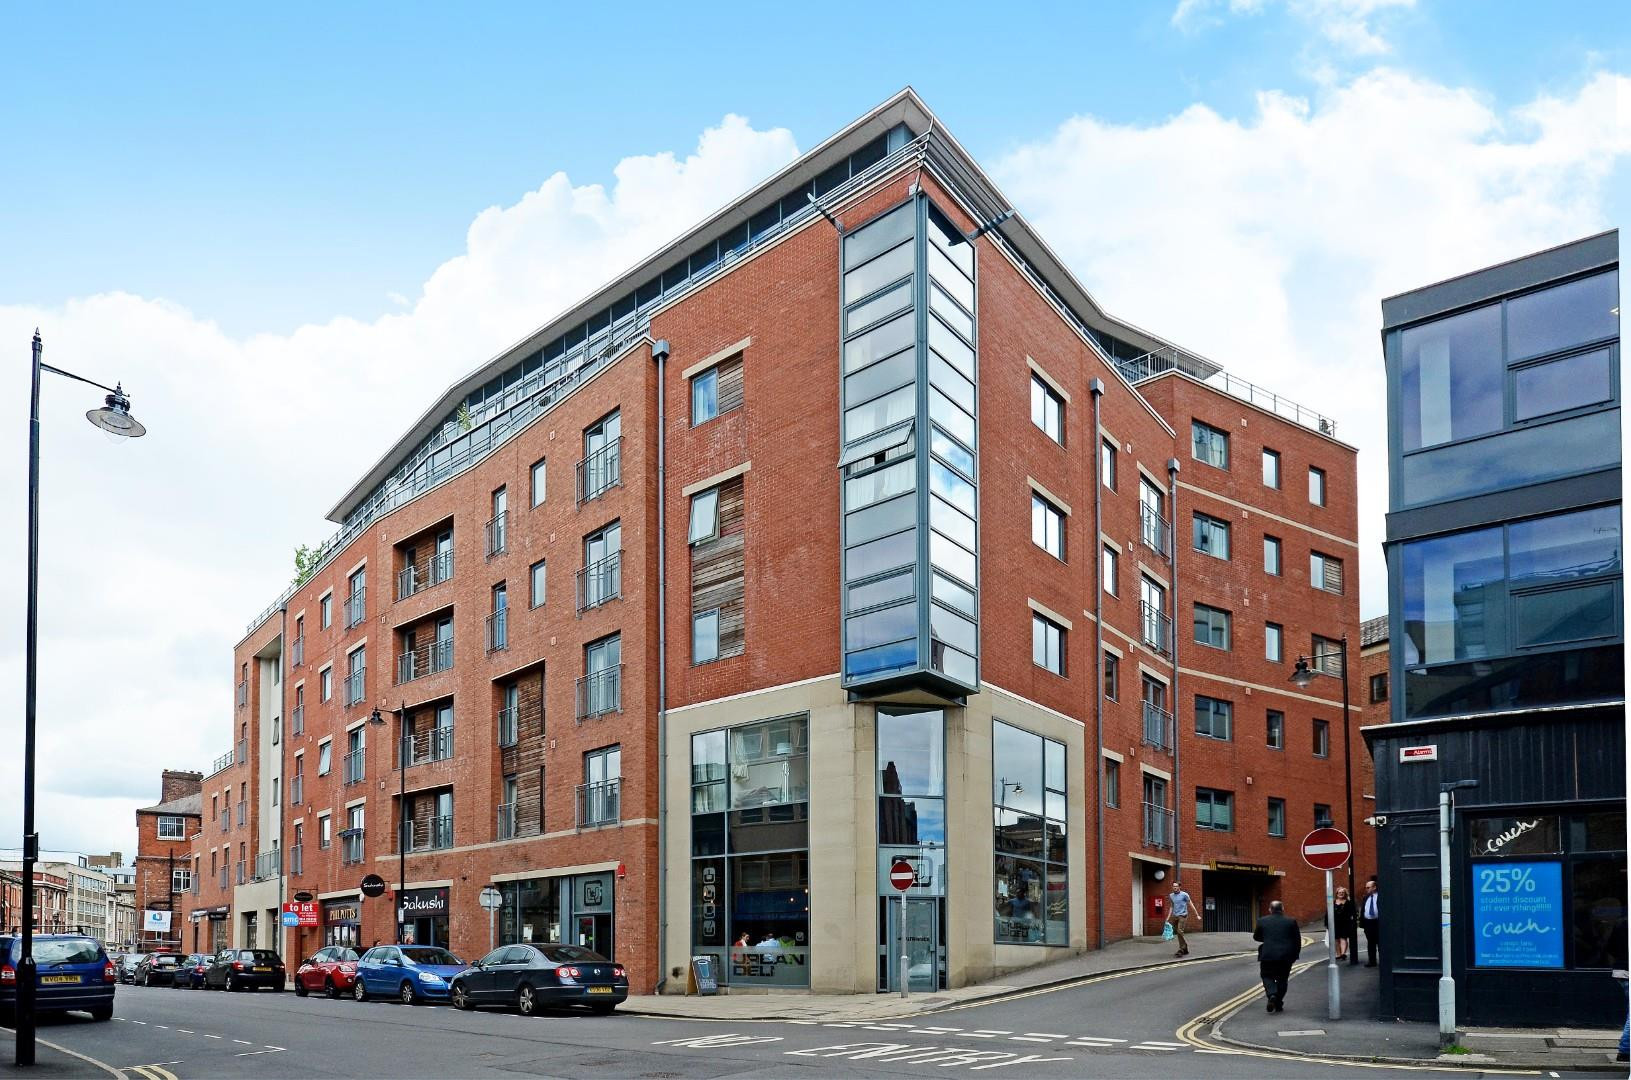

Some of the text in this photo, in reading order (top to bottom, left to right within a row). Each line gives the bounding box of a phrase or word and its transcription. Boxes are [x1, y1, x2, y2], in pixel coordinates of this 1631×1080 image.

[1480, 867, 1536, 893] 25%
[1512, 895, 1547, 904] discount
[289, 903, 313, 912] to let
[733, 953, 805, 966] URBAN
[733, 965, 775, 977] DELI
[651, 1033, 785, 1049] NO
[783, 1042, 1075, 1071] ENTRY
